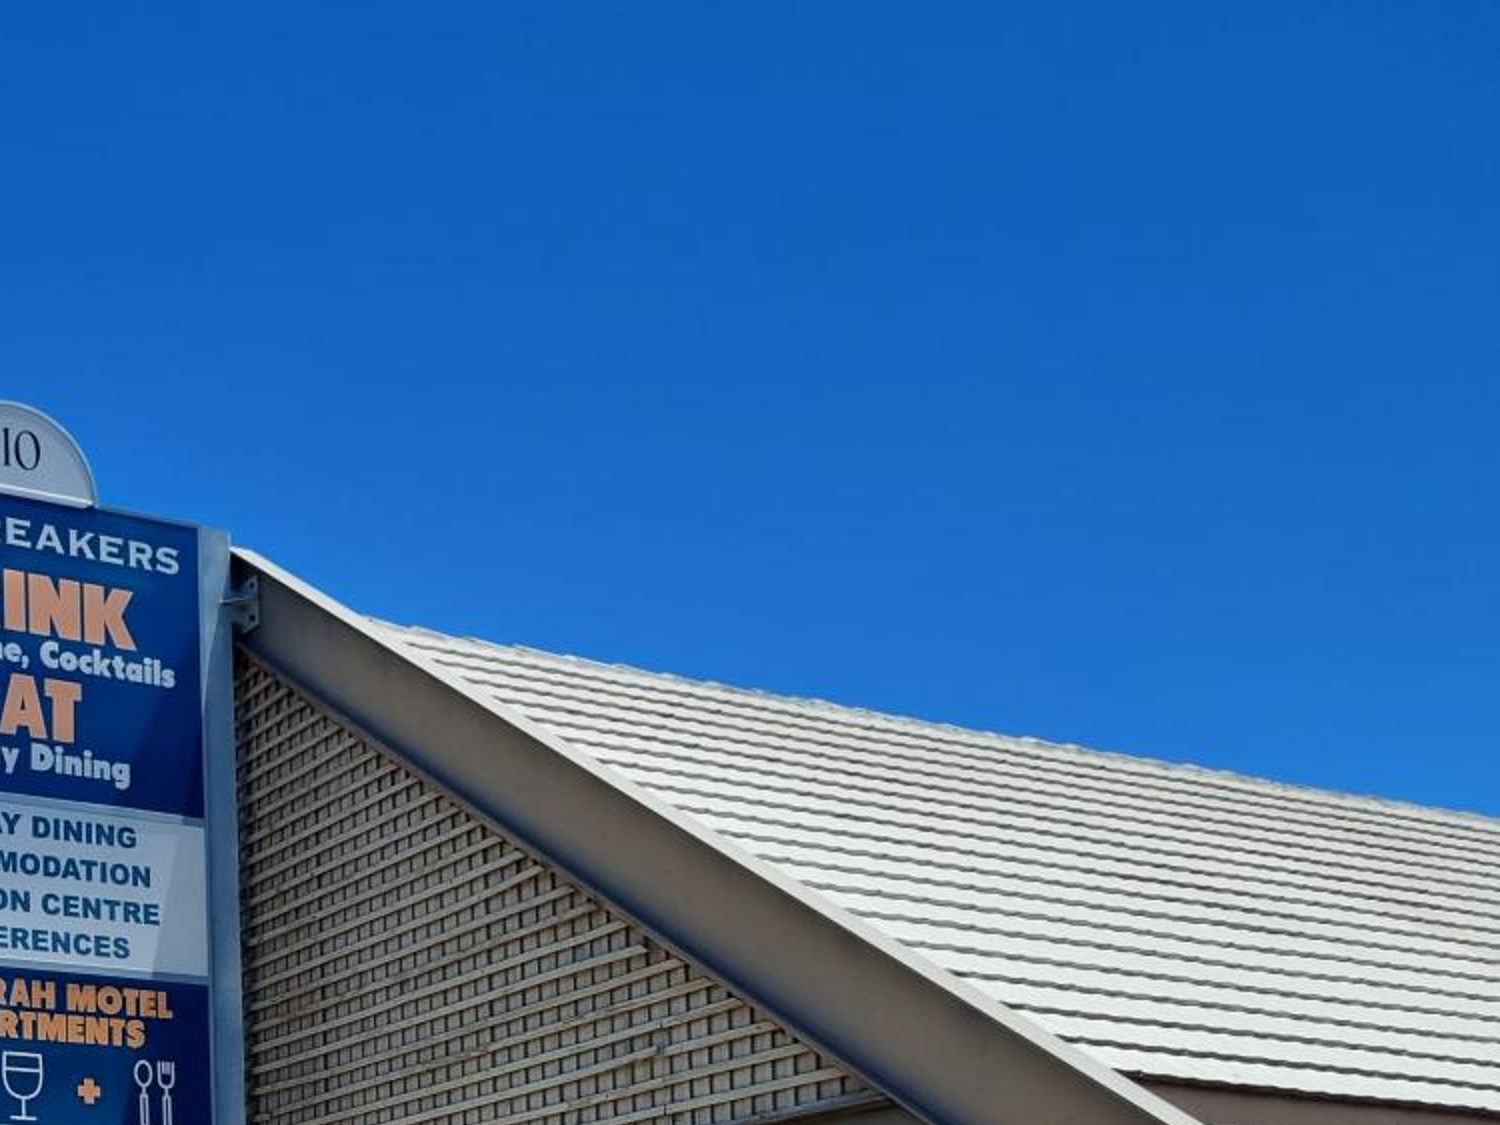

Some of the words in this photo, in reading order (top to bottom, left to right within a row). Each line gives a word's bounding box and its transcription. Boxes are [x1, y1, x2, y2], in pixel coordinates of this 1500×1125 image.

[40, 641, 176, 689] Cocktails
[31, 742, 131, 789] Dining
[31, 814, 137, 850] DINING
[41, 892, 161, 927] CENTRE
[66, 983, 173, 1019] MOTEL
